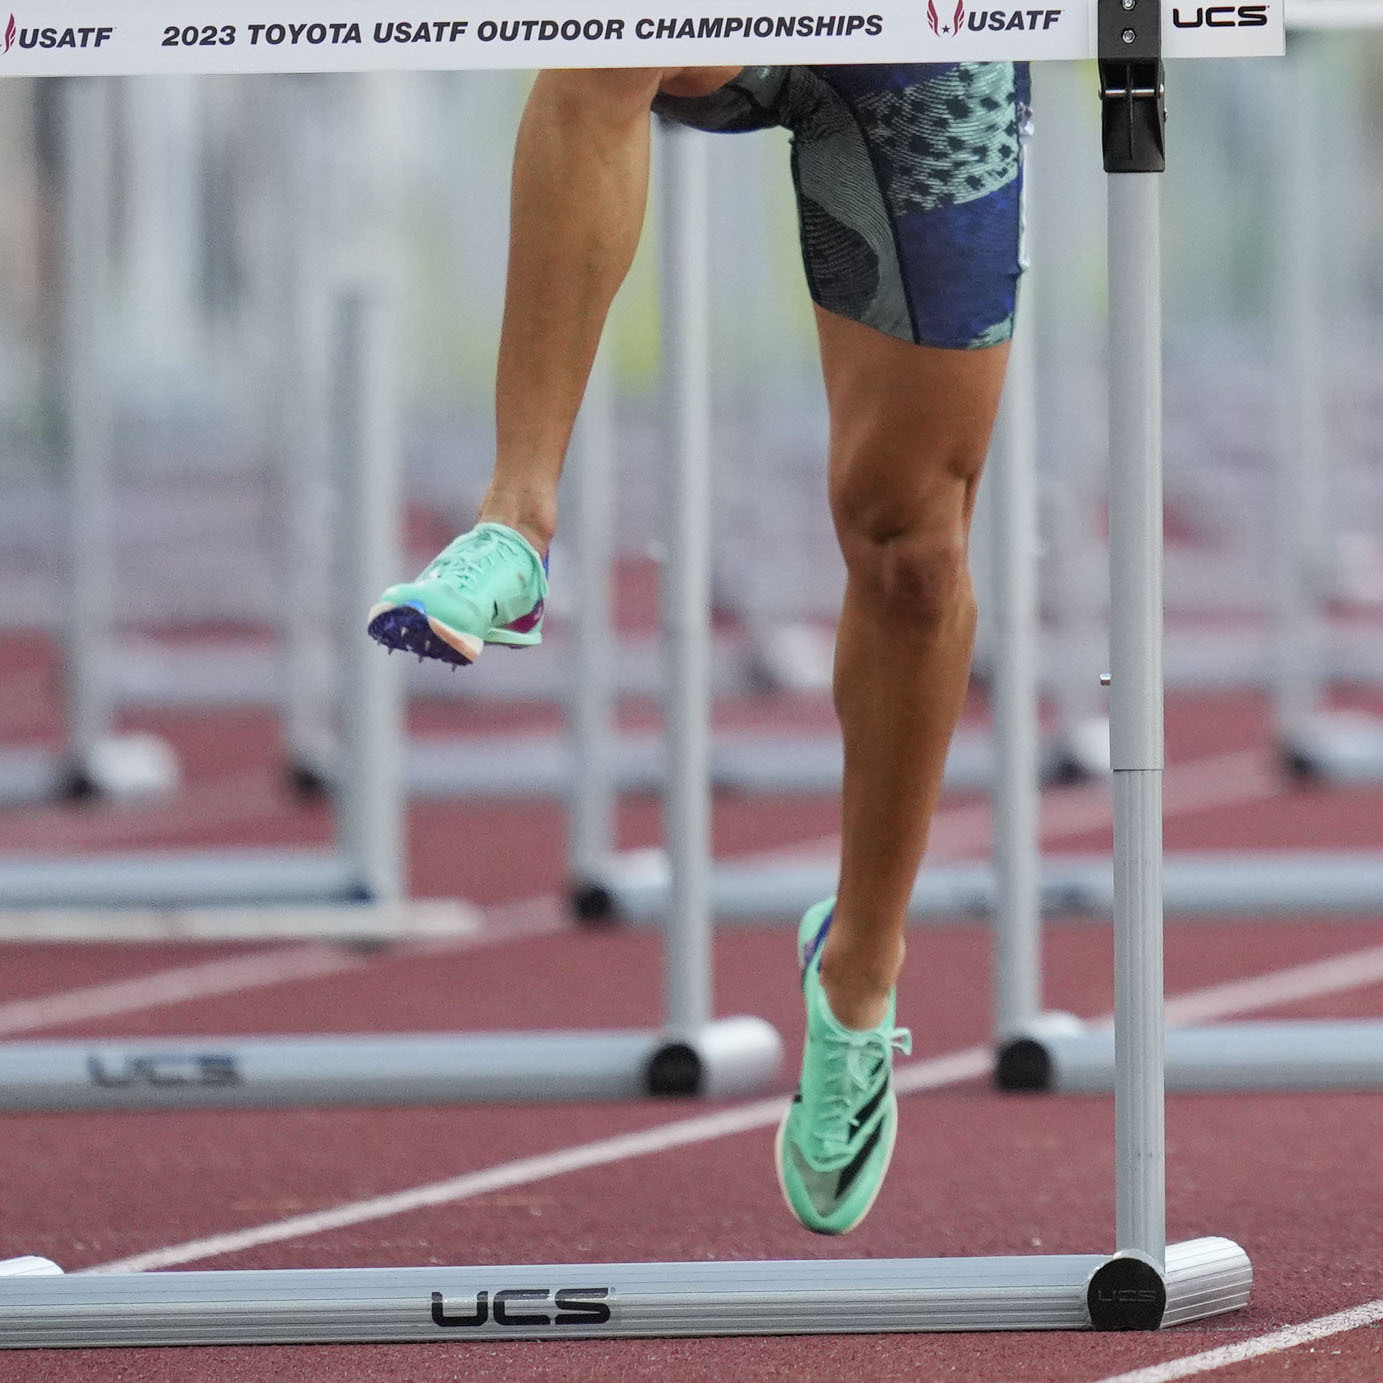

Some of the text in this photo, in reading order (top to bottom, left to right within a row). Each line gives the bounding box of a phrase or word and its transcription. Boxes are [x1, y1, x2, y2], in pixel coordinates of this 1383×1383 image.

[967, 9, 1063, 32] USATF
[1172, 4, 1271, 29] UCS
[18, 27, 114, 50] USATF
[161, 16, 884, 47] 2023 TOYOTA USATF OUTDOOR CHAMPIONSHIPS
[431, 1287, 612, 1327] UCS
